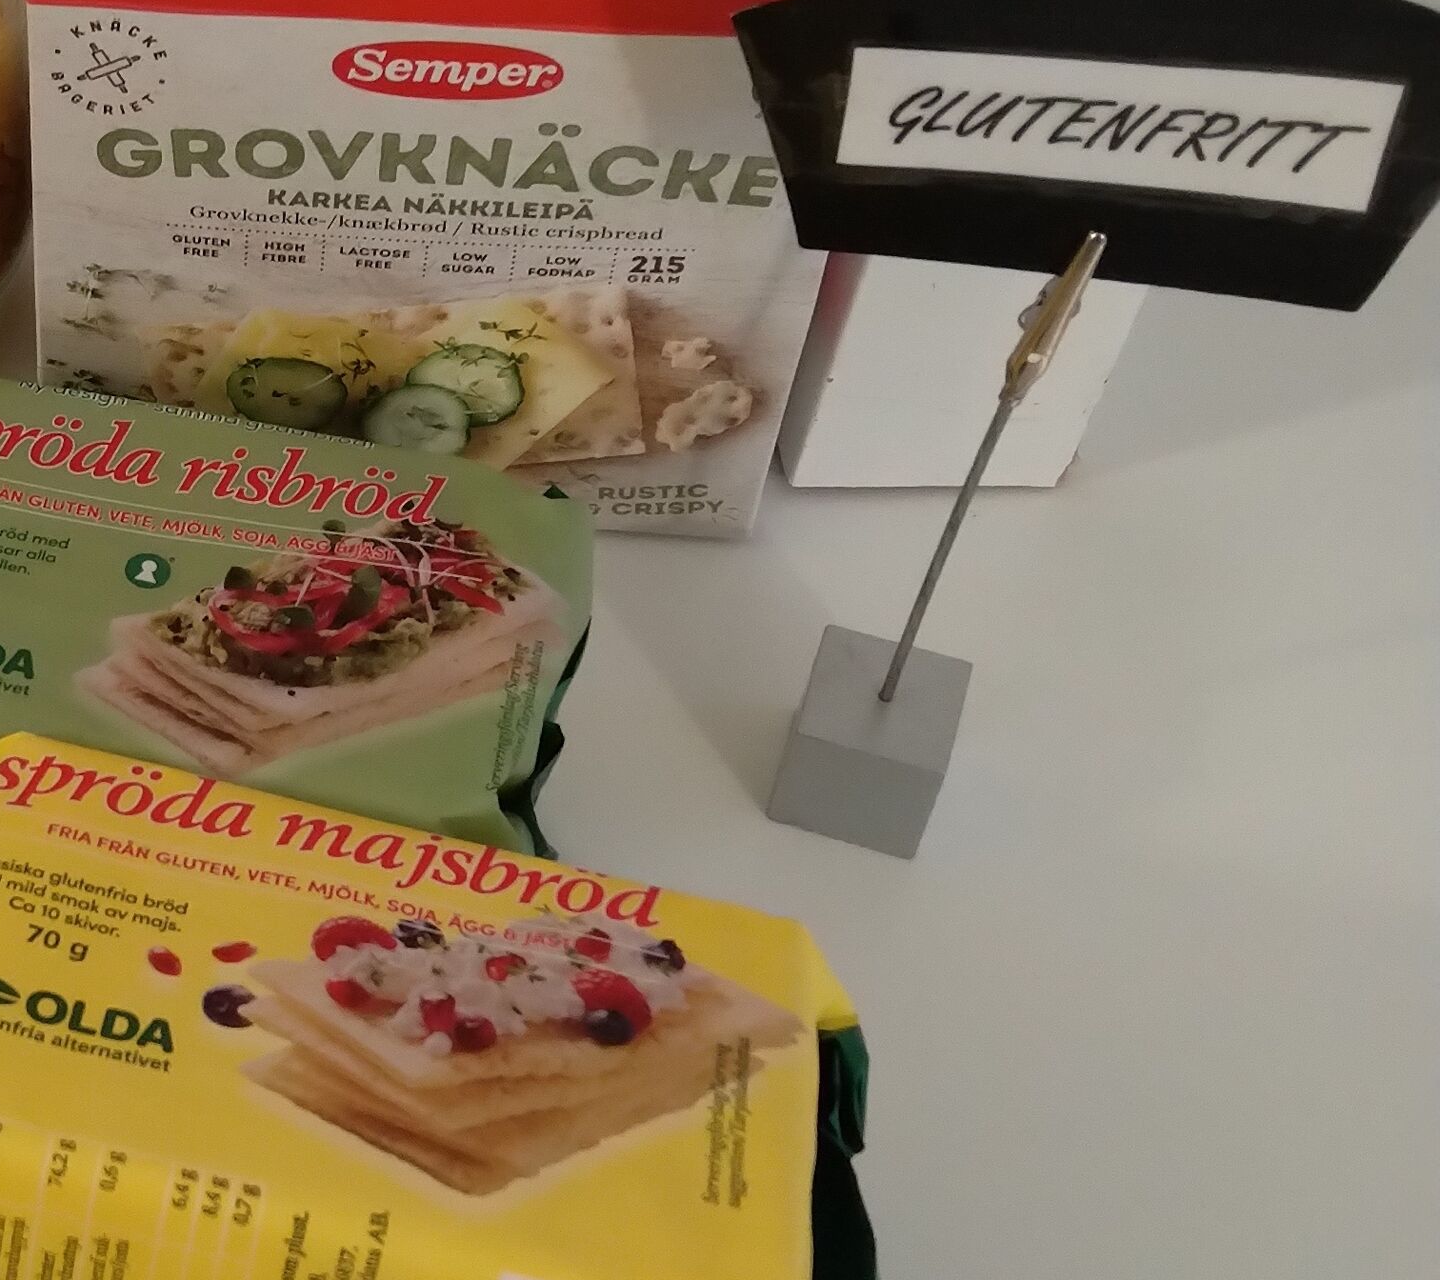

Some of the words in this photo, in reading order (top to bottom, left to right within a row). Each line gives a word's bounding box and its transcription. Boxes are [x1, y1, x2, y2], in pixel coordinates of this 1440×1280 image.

[70, 18, 167, 61] KNÄCKE
[348, 46, 549, 94] Semper
[889, 86, 1371, 173] GLUTENFRITT
[96, 122, 779, 208] GROVKNÄCKE
[267, 188, 393, 213] KARKEA
[403, 193, 595, 221] NÄKKILEIPÄ
[172, 234, 231, 247] GLUTEN
[470, 222, 539, 239] Rustic
[545, 227, 664, 243] crispbread
[183, 247, 220, 258] FREE
[264, 241, 305, 252] HIGH
[339, 247, 411, 259] LACTOSE
[261, 253, 307, 264] FIBRE
[356, 259, 392, 269] FREE
[452, 252, 488, 263] LOW
[546, 256, 582, 266] LOW
[629, 255, 686, 274] 215
[441, 264, 496, 275] SUGAR
[528, 267, 596, 279] FODMAP
[627, 274, 681, 284] GRAM
[176, 447, 448, 525] risbröd
[598, 484, 709, 500] RUSTIC
[612, 500, 724, 516] CRISPY
[28, 493, 102, 523] GLUTEN,
[108, 508, 157, 532] VETE,
[162, 517, 228, 543] MJÖLK,
[233, 528, 281, 548] SOJA,
[287, 533, 332, 553] ÄGG
[32, 535, 72, 550] med
[26, 548, 57, 563] alla
[47, 823, 92, 846] FRIA
[97, 833, 150, 860] FRÅN
[155, 850, 241, 881] GLUTEN,
[247, 868, 301, 892] VETE,
[308, 878, 381, 910] MJÖLK,
[448, 912, 496, 937] ÄGG
[277, 812, 663, 928] majsbröd
[49, 872, 138, 905] glutenfria
[143, 893, 190, 916] bröd
[6, 879, 48, 898] mild
[51, 891, 99, 914] smak
[104, 906, 129, 920] av
[132, 912, 182, 933] majs.
[9, 896, 35, 914] Ca
[41, 904, 60, 920] 10
[64, 914, 121, 938] skivor.
[26, 923, 61, 950] 70
[68, 941, 90, 962] g
[26, 991, 175, 1054] OLDA
[51, 1032, 173, 1073] alternativet
